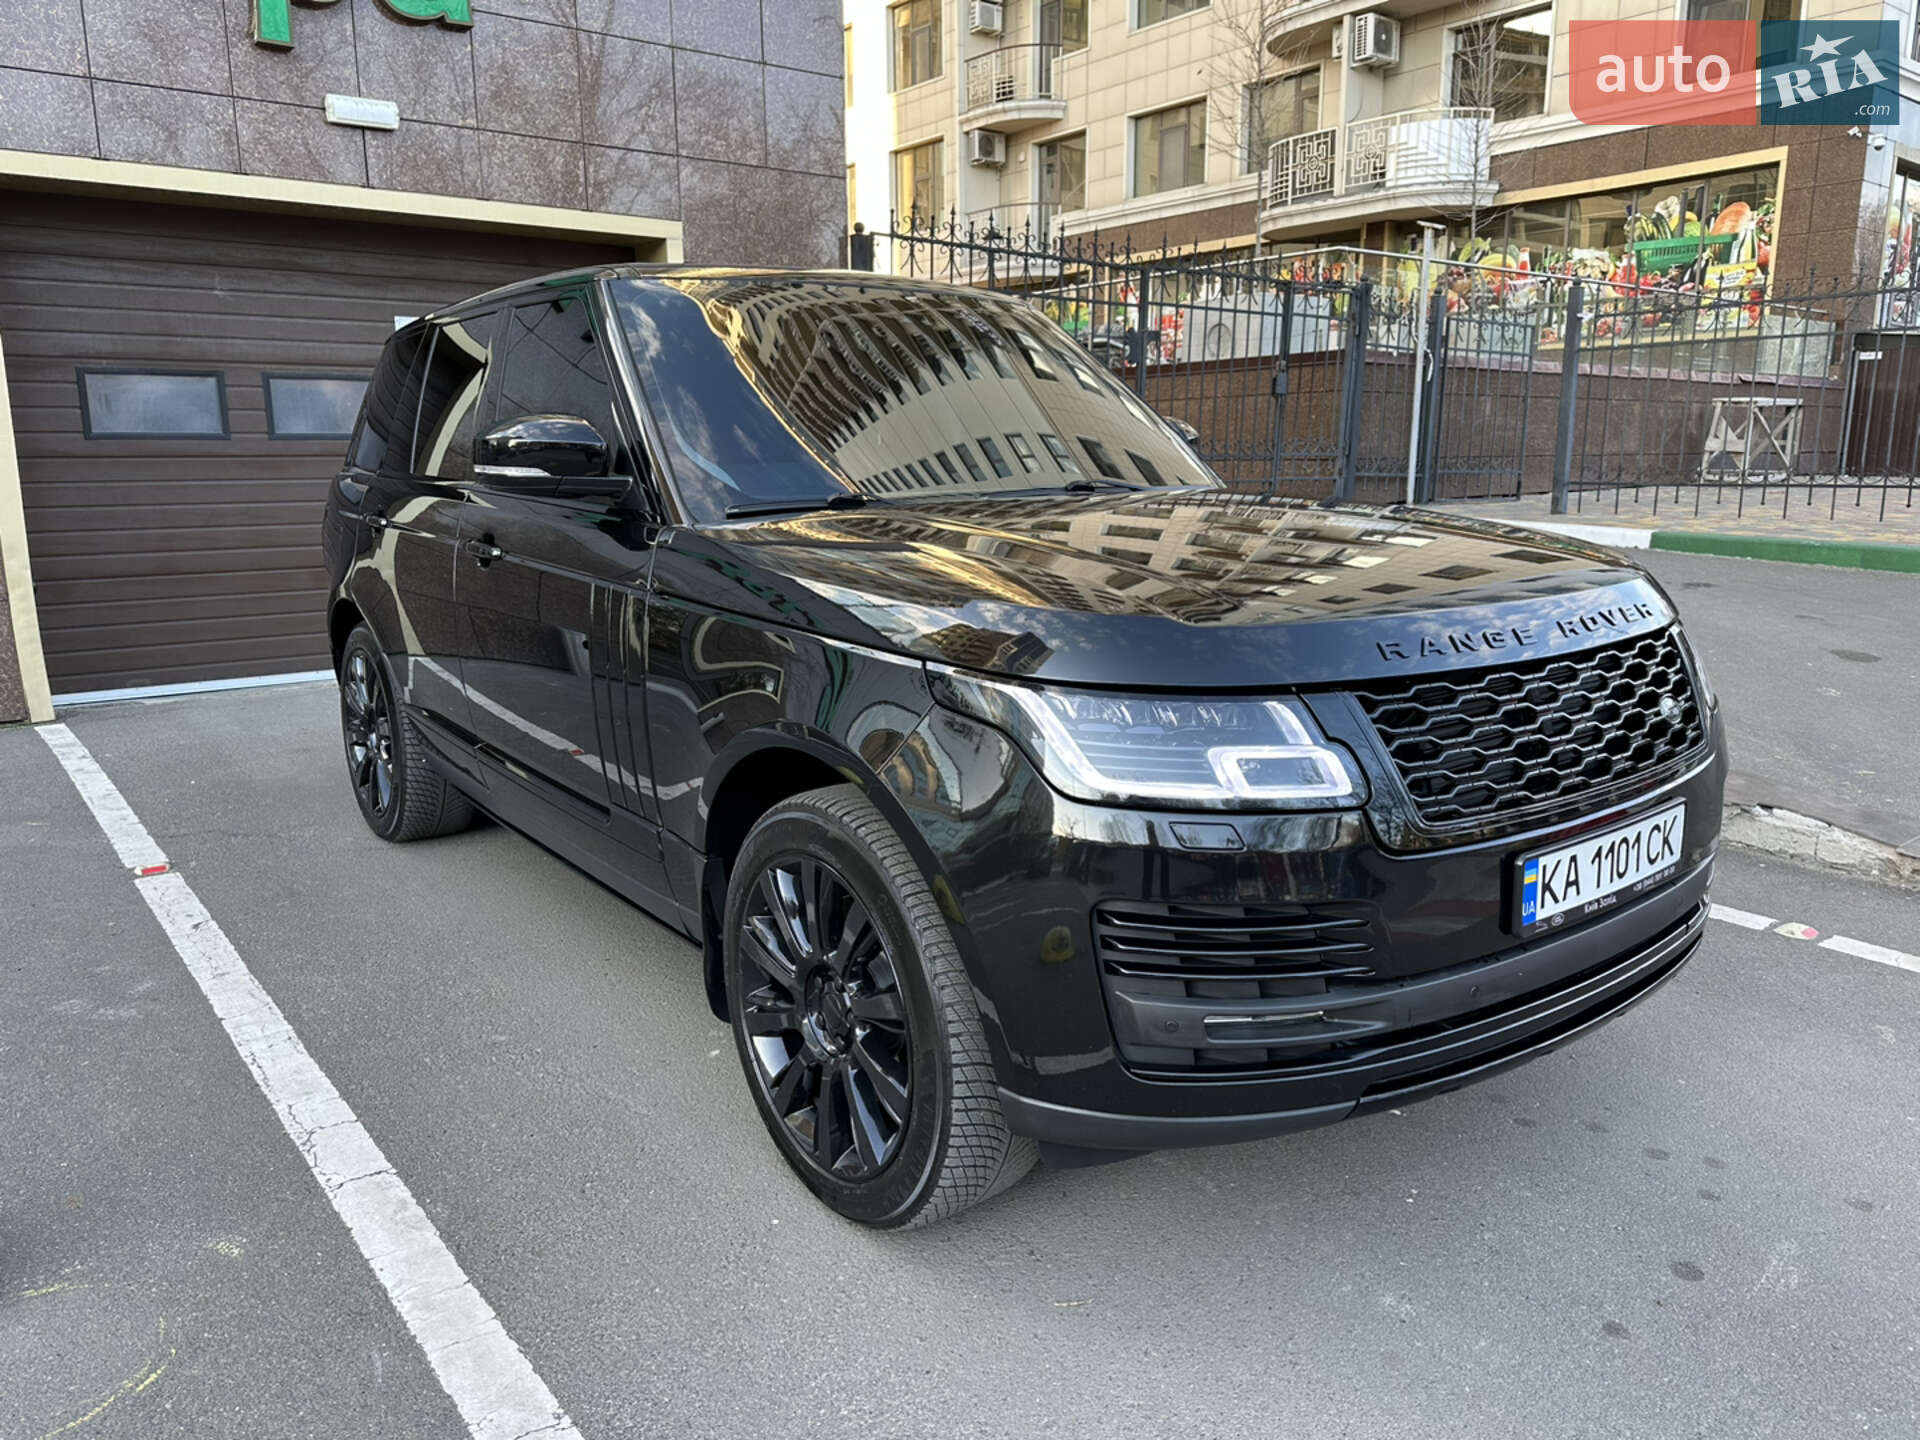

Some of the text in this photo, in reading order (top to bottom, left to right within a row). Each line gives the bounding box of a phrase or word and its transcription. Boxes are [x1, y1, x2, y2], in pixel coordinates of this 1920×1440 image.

[1376, 602, 1655, 662] RANGE ROVER
[1522, 900, 1536, 916] UA
[1540, 854, 1581, 909] KA
